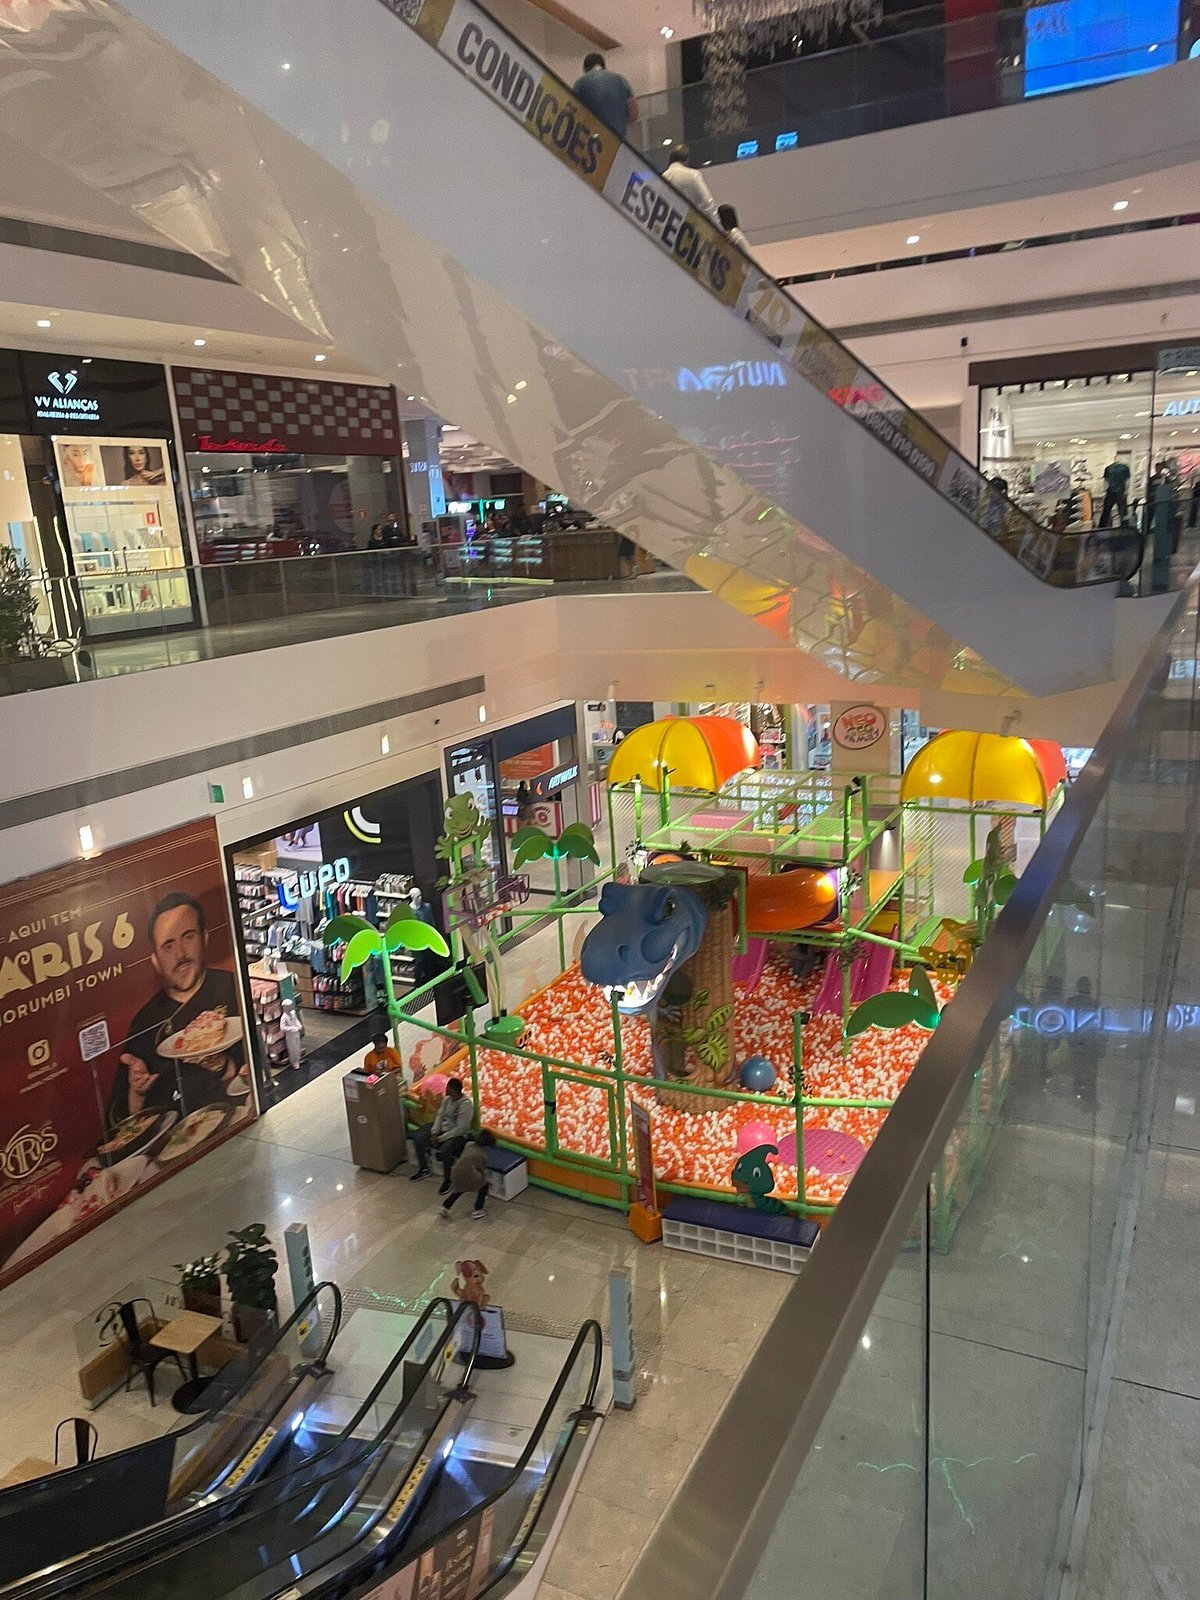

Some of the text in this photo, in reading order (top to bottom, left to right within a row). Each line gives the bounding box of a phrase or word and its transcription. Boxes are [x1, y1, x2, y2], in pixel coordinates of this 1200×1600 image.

[458, 22, 602, 174] CONDIÇÕES
[34, 396, 99, 412] VV ALIANÇAS
[279, 857, 350, 911] LUPO
[8, 907, 81, 943] AQUI TEM
[113, 912, 135, 949] 6
[0, 985, 71, 1027] ORUMBI
[75, 963, 123, 991] TOWN
